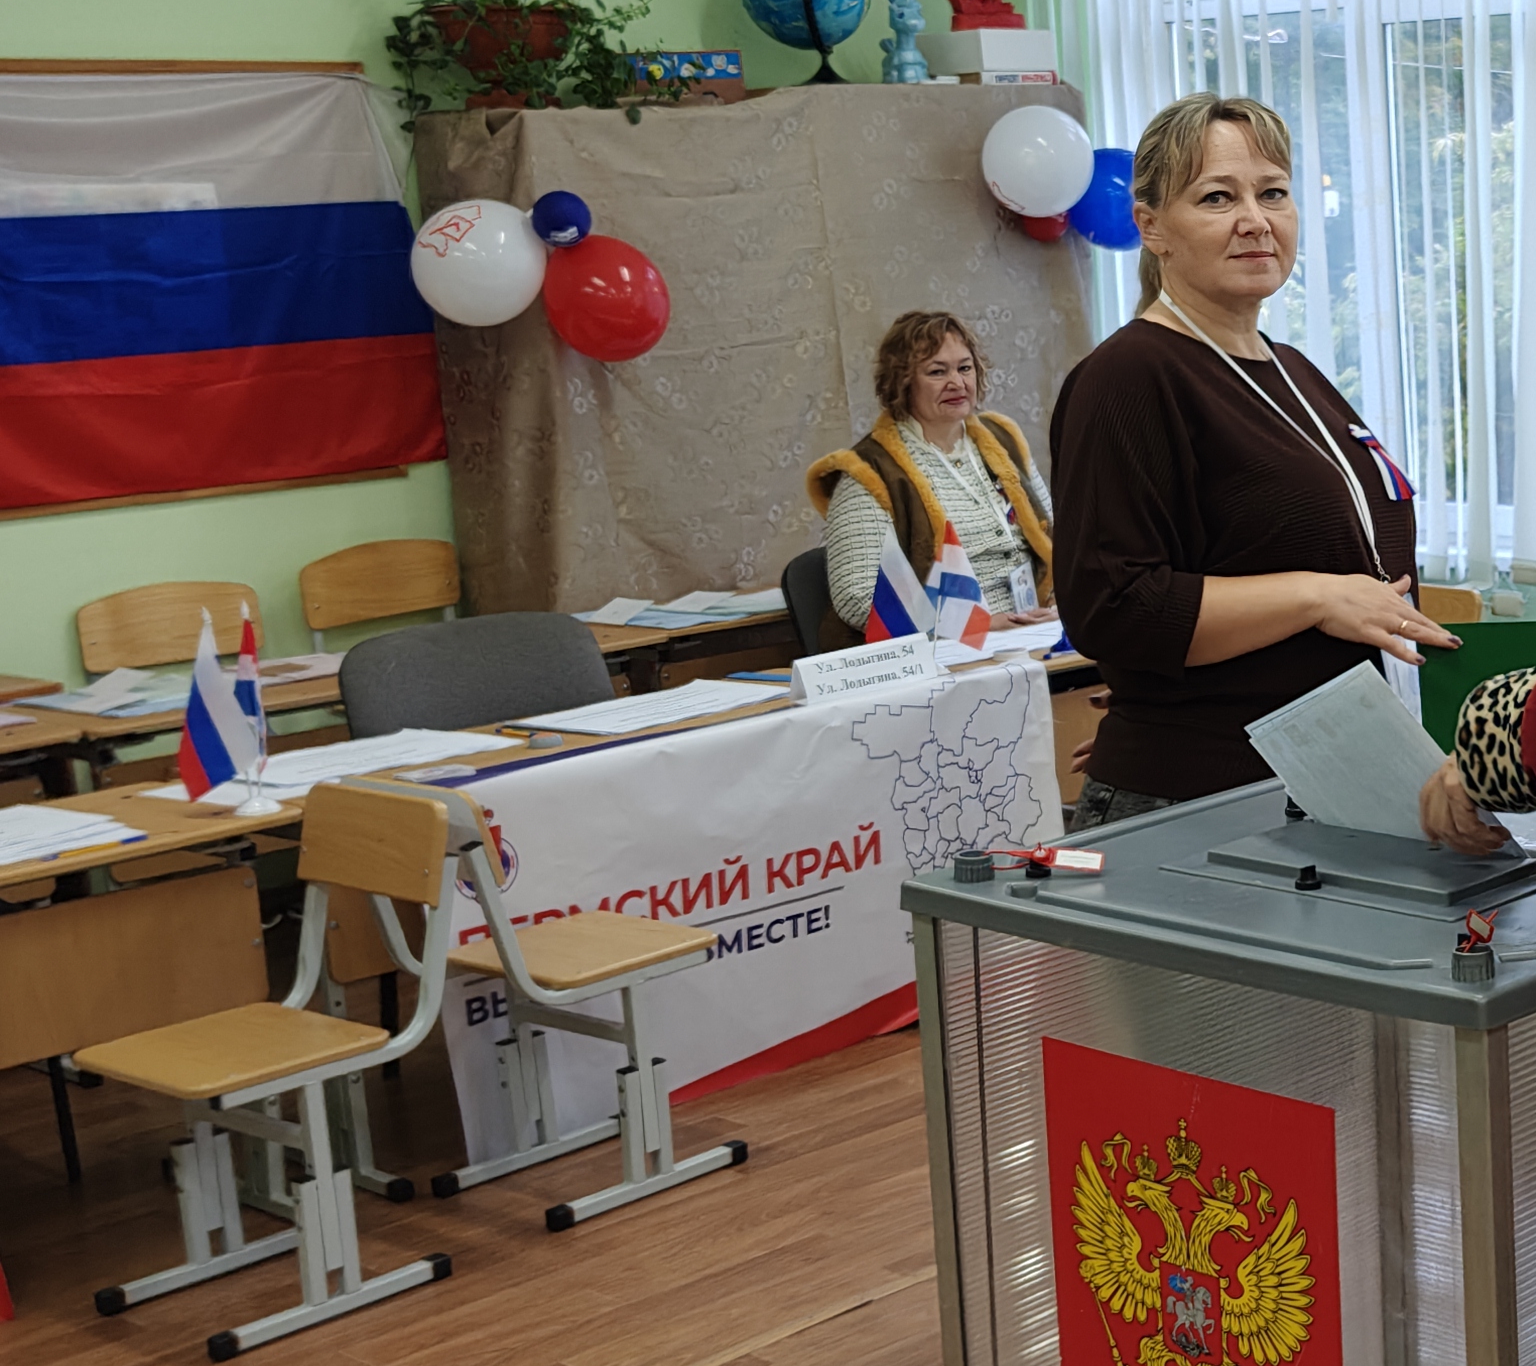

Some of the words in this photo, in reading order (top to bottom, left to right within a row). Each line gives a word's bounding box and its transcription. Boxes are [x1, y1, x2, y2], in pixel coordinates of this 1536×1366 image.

[814, 661, 837, 674] Ул.
[840, 650, 901, 669] Лодыгина,
[901, 644, 915, 658] 54
[816, 683, 838, 695] Ул.
[840, 671, 901, 691] Лодыгина,
[902, 663, 924, 677] 54/1
[765, 821, 883, 894] КРАЙ
